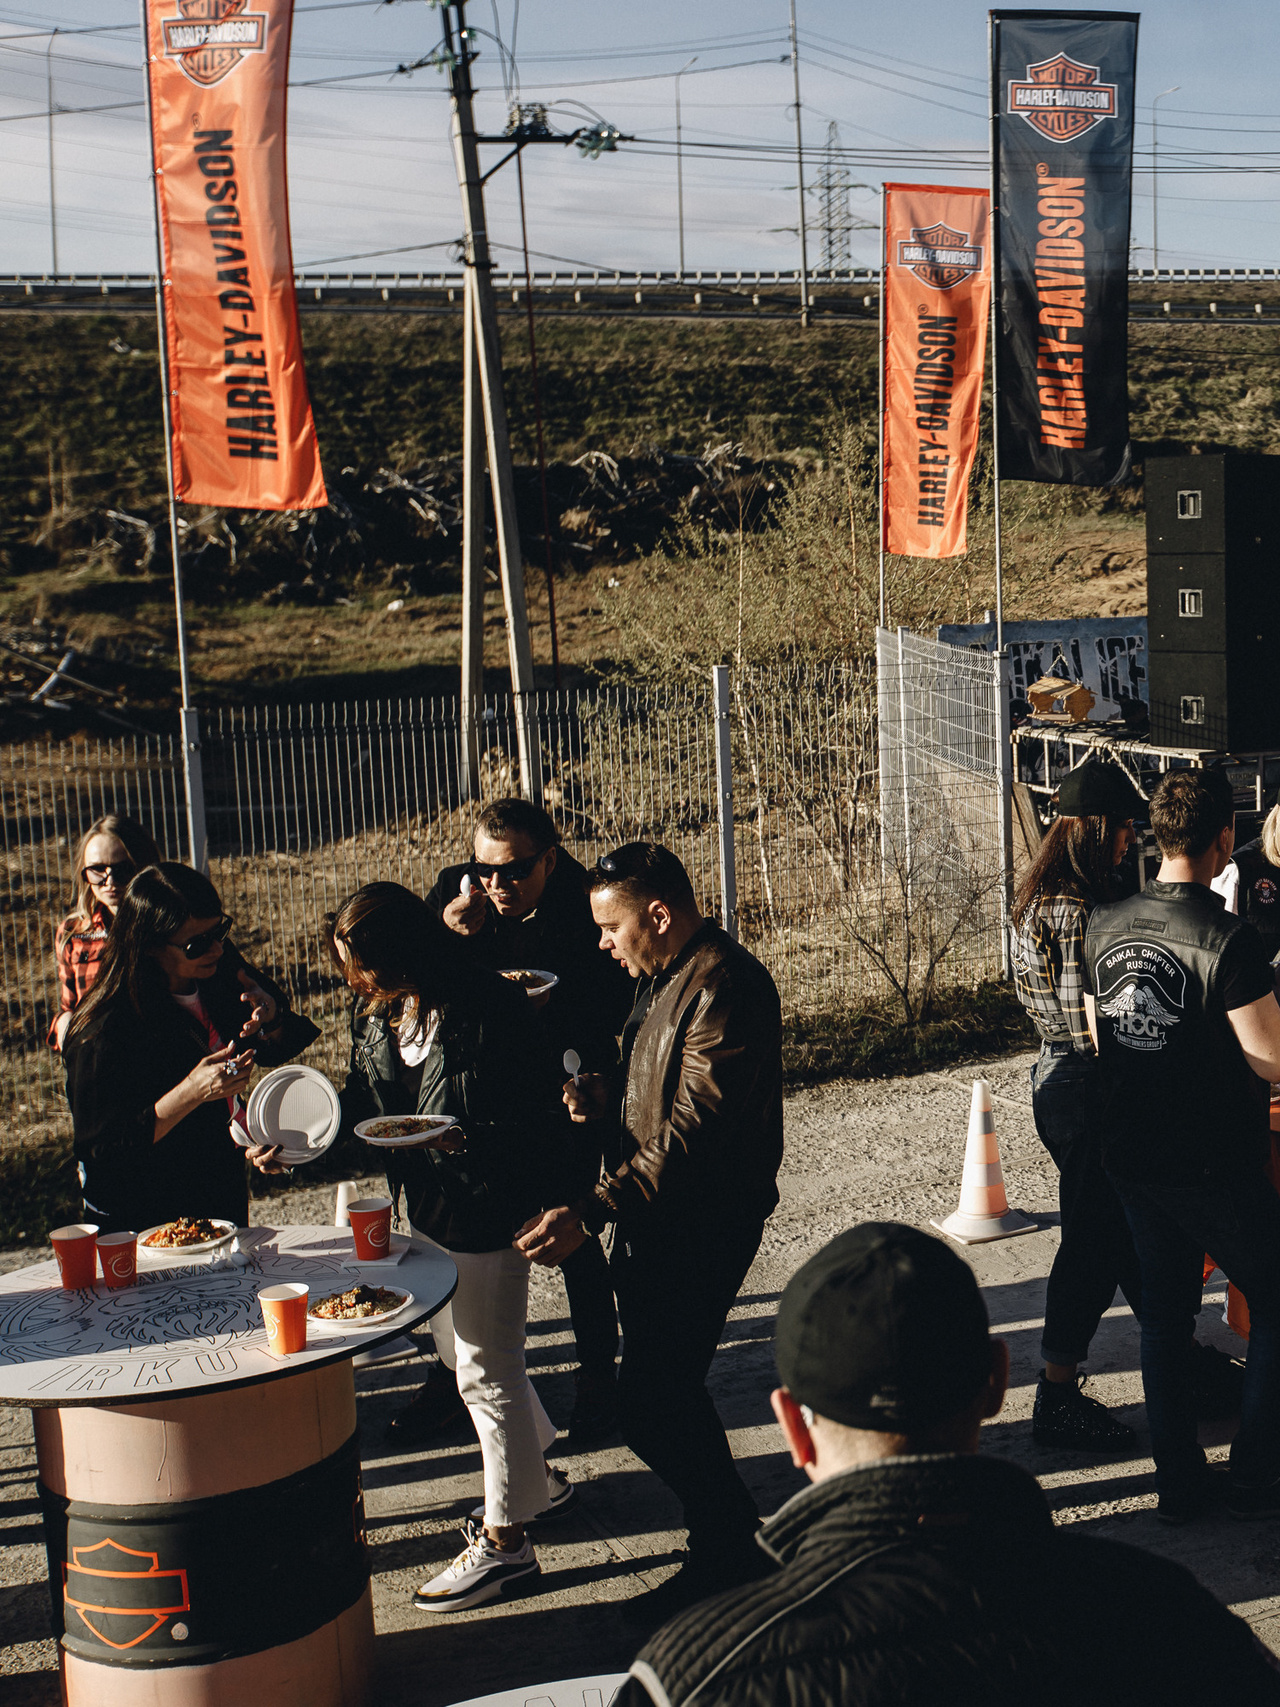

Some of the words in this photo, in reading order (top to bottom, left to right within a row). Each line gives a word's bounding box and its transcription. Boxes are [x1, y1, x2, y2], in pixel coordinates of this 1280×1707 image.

[1038, 62, 1087, 85] MOTOR
[1016, 88, 1109, 108] HARLEY-DAVIDSON
[1037, 111, 1086, 134] CYCLES
[193, 129, 279, 461] HARLEY-DAVIDSON
[1036, 176, 1087, 449] HARLEY-DAVIDSON
[914, 315, 958, 529] HARLEY-DAVIDSON
[1105, 948, 1137, 969] BAIKAL
[1141, 948, 1176, 978] CHAPTER
[1126, 960, 1157, 974] RUSSIA
[1119, 1010, 1159, 1038] HOG
